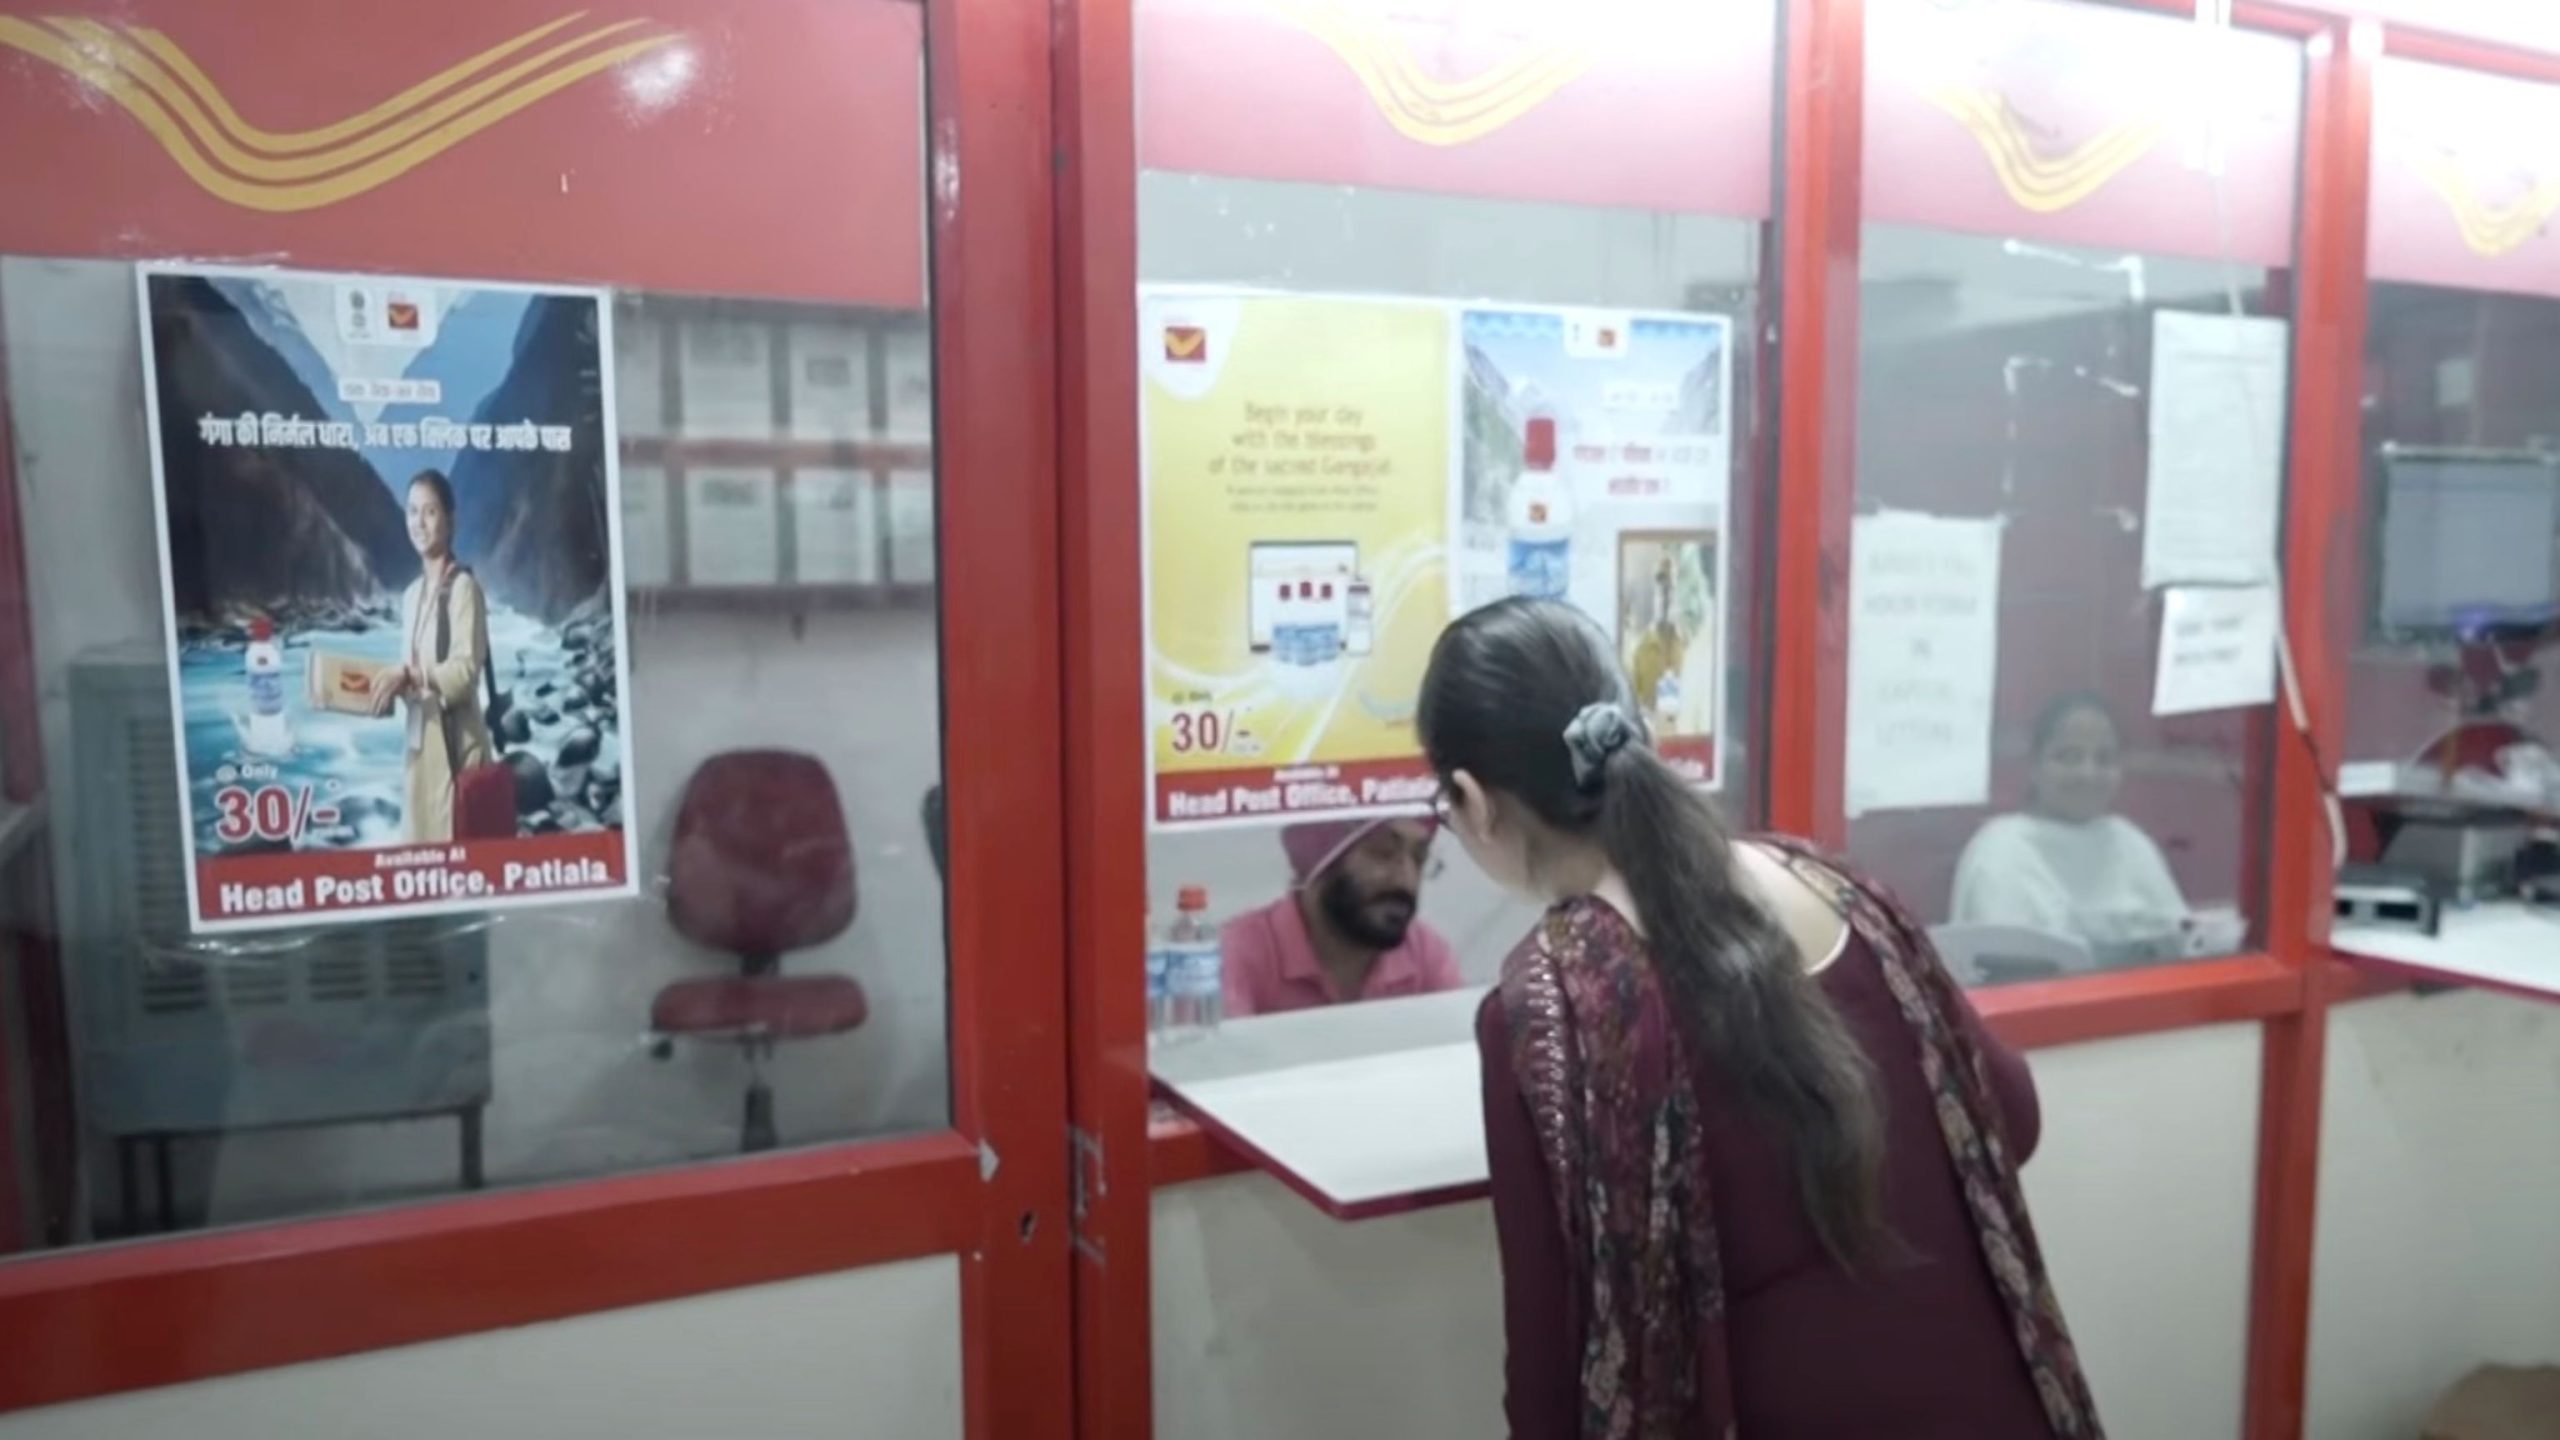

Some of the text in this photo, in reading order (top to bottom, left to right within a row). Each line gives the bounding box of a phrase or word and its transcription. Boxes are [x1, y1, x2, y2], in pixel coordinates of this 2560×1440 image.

[198, 412, 234, 446] गंगा
[236, 412, 259, 446] की
[262, 412, 316, 447] निर्मल
[365, 422, 389, 447] अब
[391, 423, 418, 448] एक
[469, 423, 493, 450] पर
[495, 417, 538, 450] आपके
[540, 424, 571, 451] पास
[1168, 790, 1227, 816] Head
[1233, 786, 1280, 812] Post
[375, 849, 445, 868] Available
[220, 856, 608, 914] Head Post Office, Patiala
